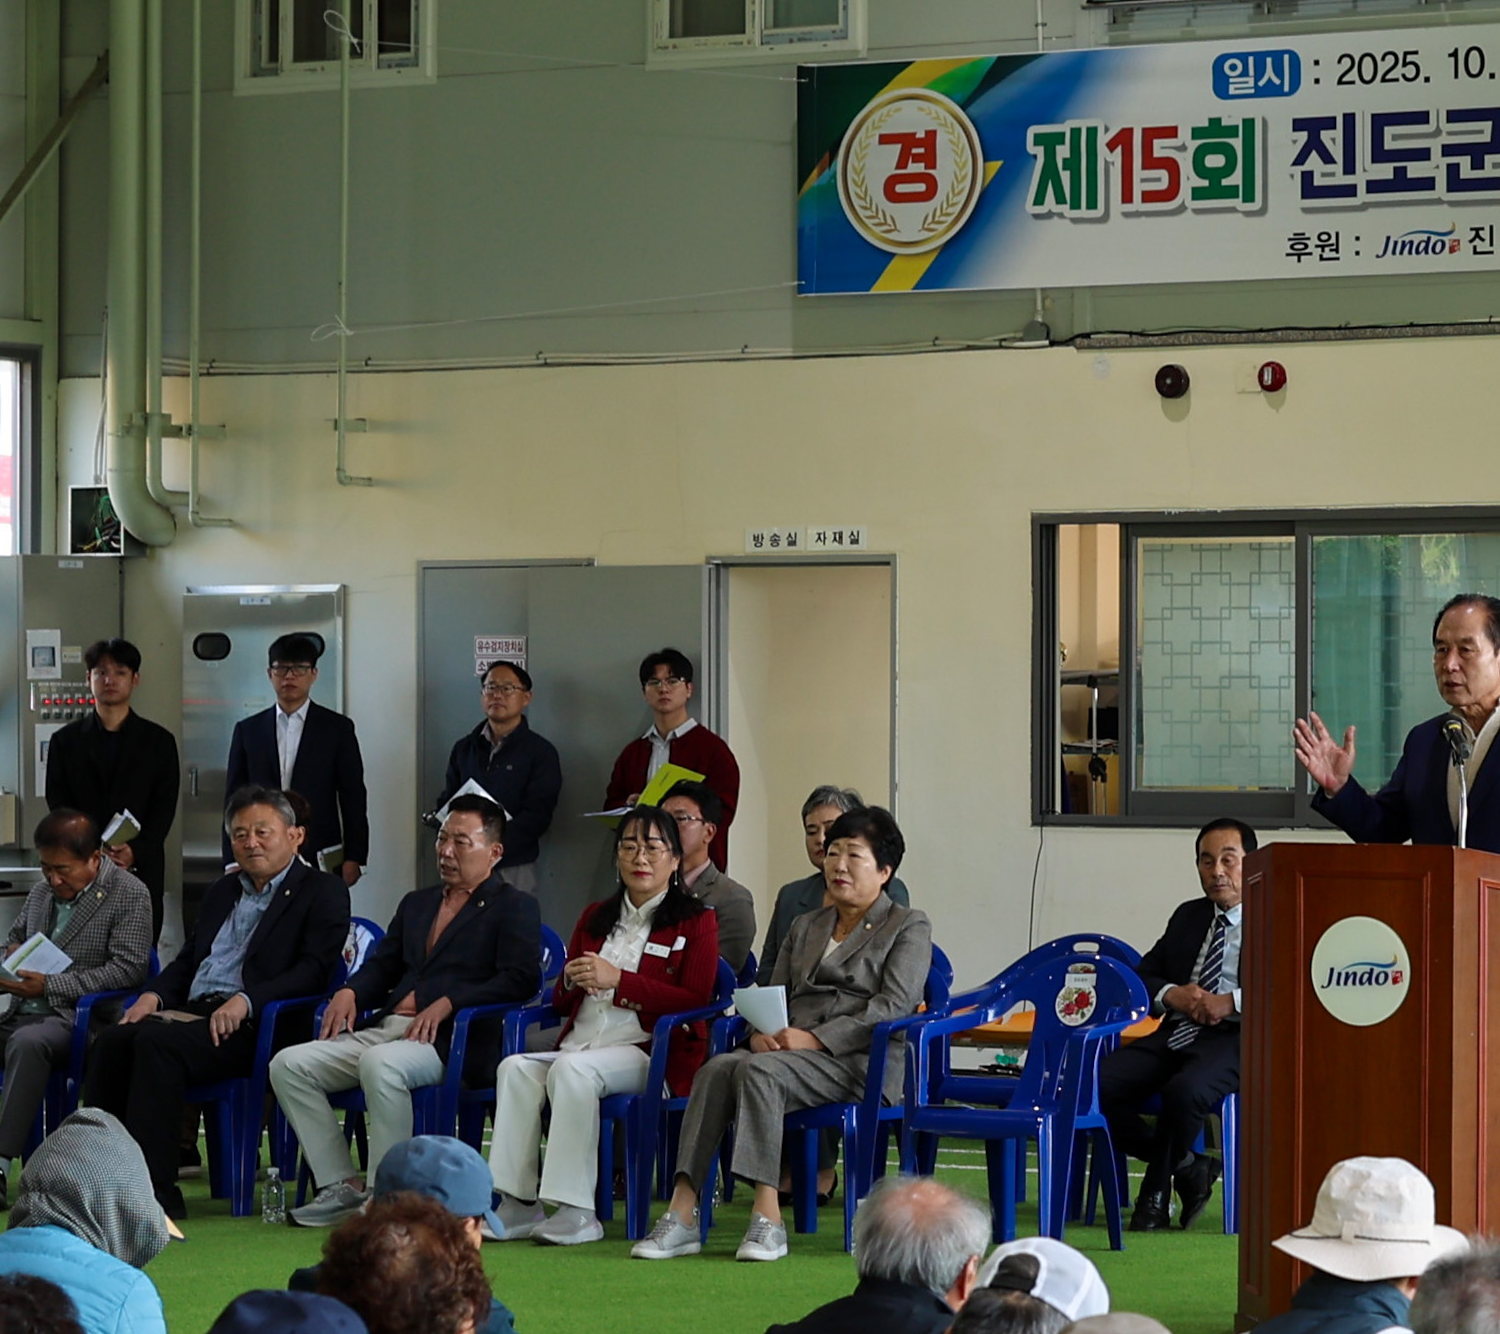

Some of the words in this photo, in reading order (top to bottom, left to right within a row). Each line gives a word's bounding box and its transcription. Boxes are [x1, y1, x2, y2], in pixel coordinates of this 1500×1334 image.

[1222, 54, 1290, 95] 일시
[1336, 50, 1430, 85] 2025.
[1447, 46, 1496, 80] 10.
[878, 129, 938, 204] 경
[1032, 116, 1257, 211] 제15회
[1285, 230, 1341, 263] 후원
[752, 532, 798, 548] 방송실
[815, 529, 860, 546] 자재실
[1320, 967, 1389, 989] Jindo
